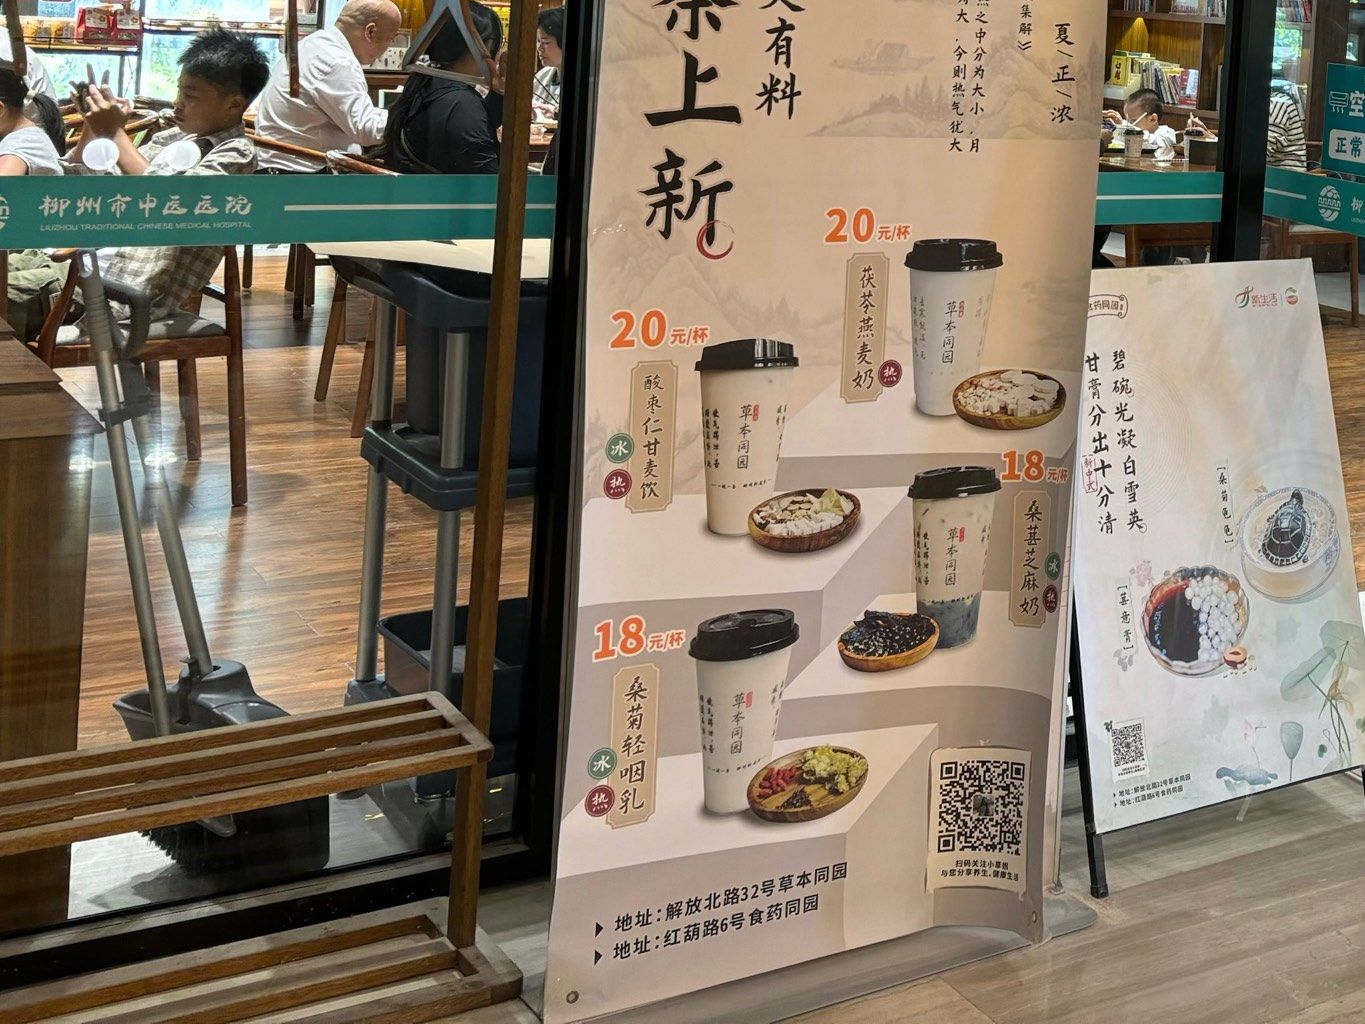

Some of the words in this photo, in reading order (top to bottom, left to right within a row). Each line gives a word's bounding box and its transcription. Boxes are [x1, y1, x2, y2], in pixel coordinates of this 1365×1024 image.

[39, 193, 253, 218] 柳州市中医医院
[852, 265, 877, 390] 茯苓燕麦奶
[942, 301, 958, 364] 草本同园
[882, 365, 898, 382] 热
[610, 440, 629, 457] 冰
[640, 374, 665, 500] 酸枣仁甘麦饮
[737, 404, 753, 470] 草本同园
[1085, 352, 1118, 535] 甘膏分出十分清
[1111, 348, 1144, 531] 碧碗光凝白雪英
[609, 476, 626, 494] 热
[945, 527, 959, 586] 草本同园
[1019, 499, 1043, 616] 桑葚芝麻奶
[593, 754, 612, 772] 冰
[618, 675, 648, 815] 桑菊轻咽乳
[591, 792, 609, 812] 热
